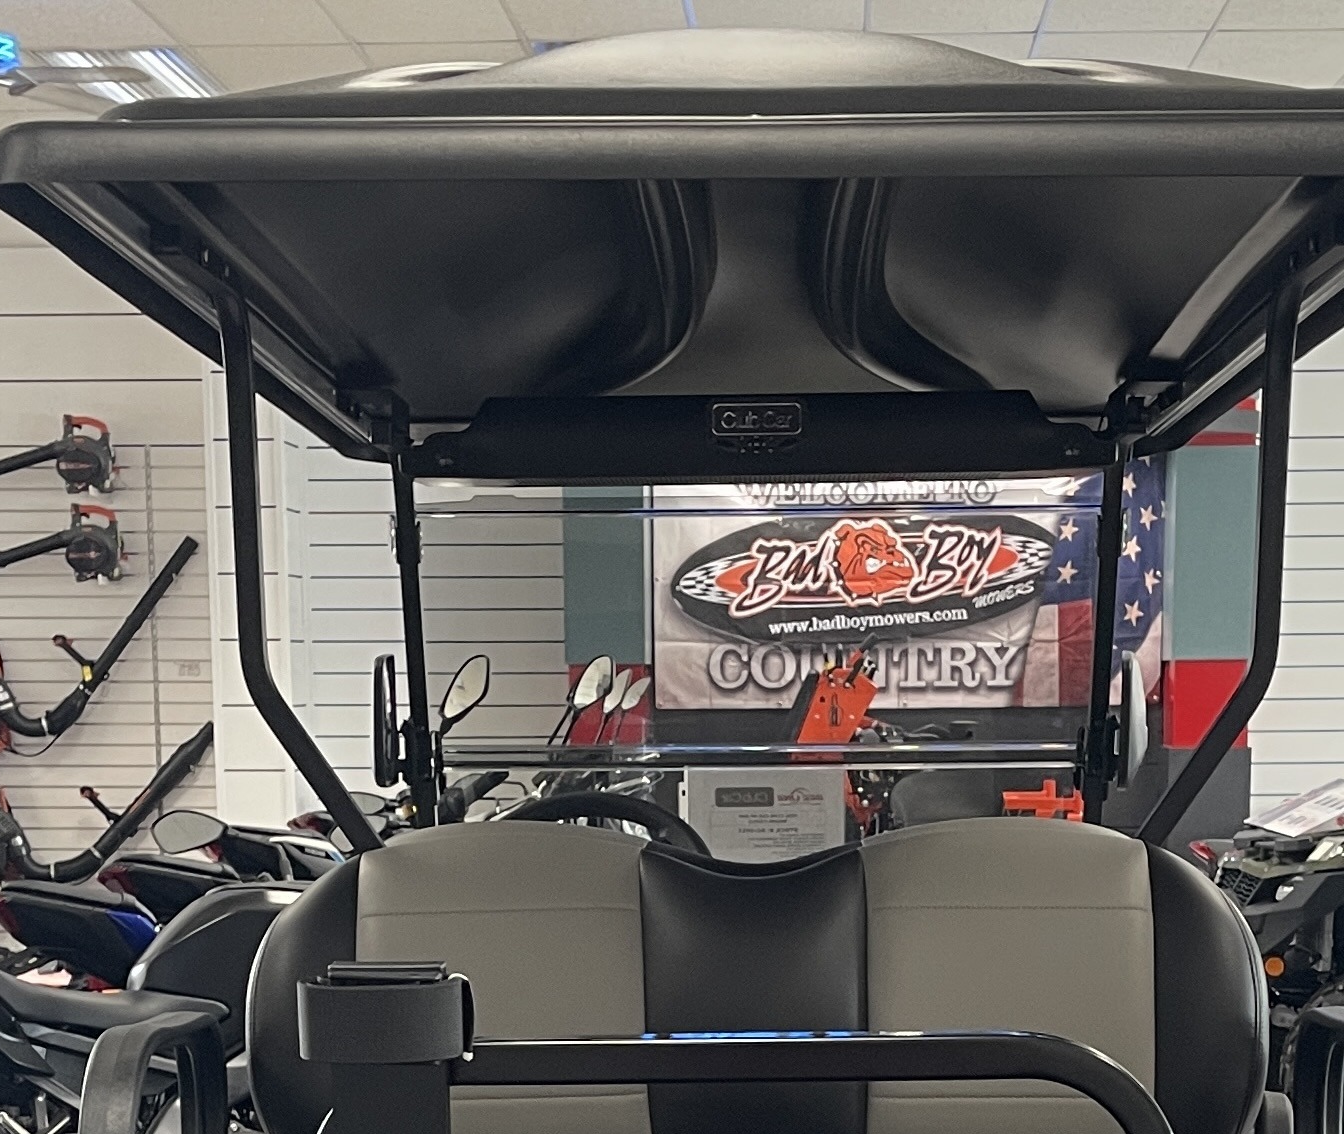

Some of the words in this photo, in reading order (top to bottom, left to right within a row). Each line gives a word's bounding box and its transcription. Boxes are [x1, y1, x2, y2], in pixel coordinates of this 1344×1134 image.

[729, 537, 838, 617] Bad
[907, 522, 1003, 603] Boy
[972, 581, 1035, 609] MOWERS
[768, 607, 968, 636] www.badboymowers.com
